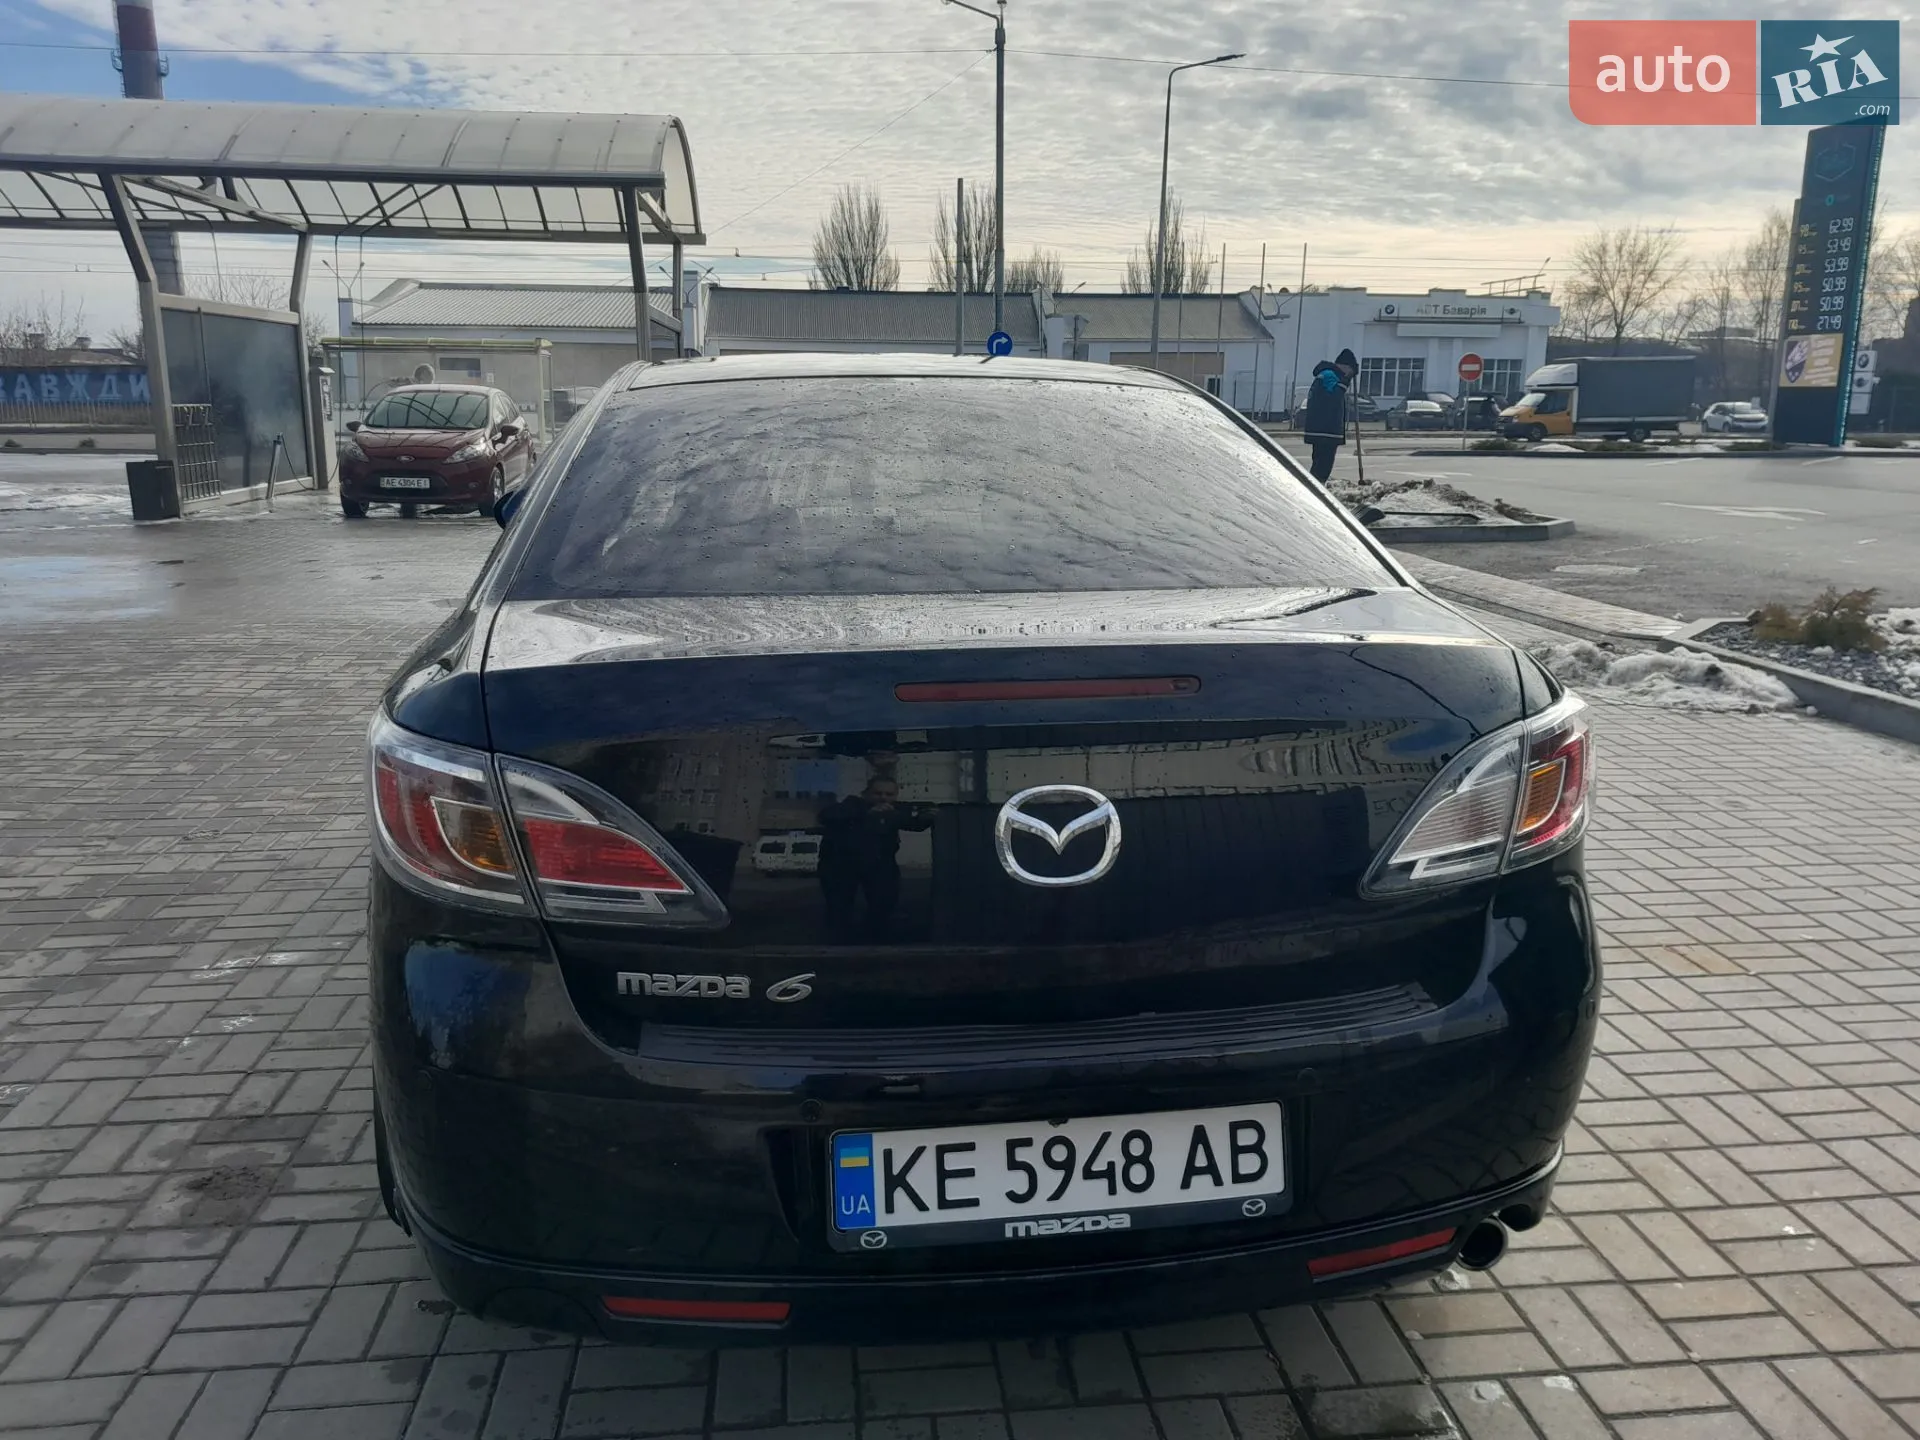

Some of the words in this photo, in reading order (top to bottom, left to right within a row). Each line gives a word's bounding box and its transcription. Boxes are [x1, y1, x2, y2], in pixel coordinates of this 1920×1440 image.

[1443, 304, 1488, 319] Баварія
[766, 972, 816, 1002] 6
[883, 1141, 980, 1215] KE
[1005, 1128, 1155, 1205] 5948
[1180, 1119, 1268, 1190] AB
[840, 1194, 872, 1216] UA
